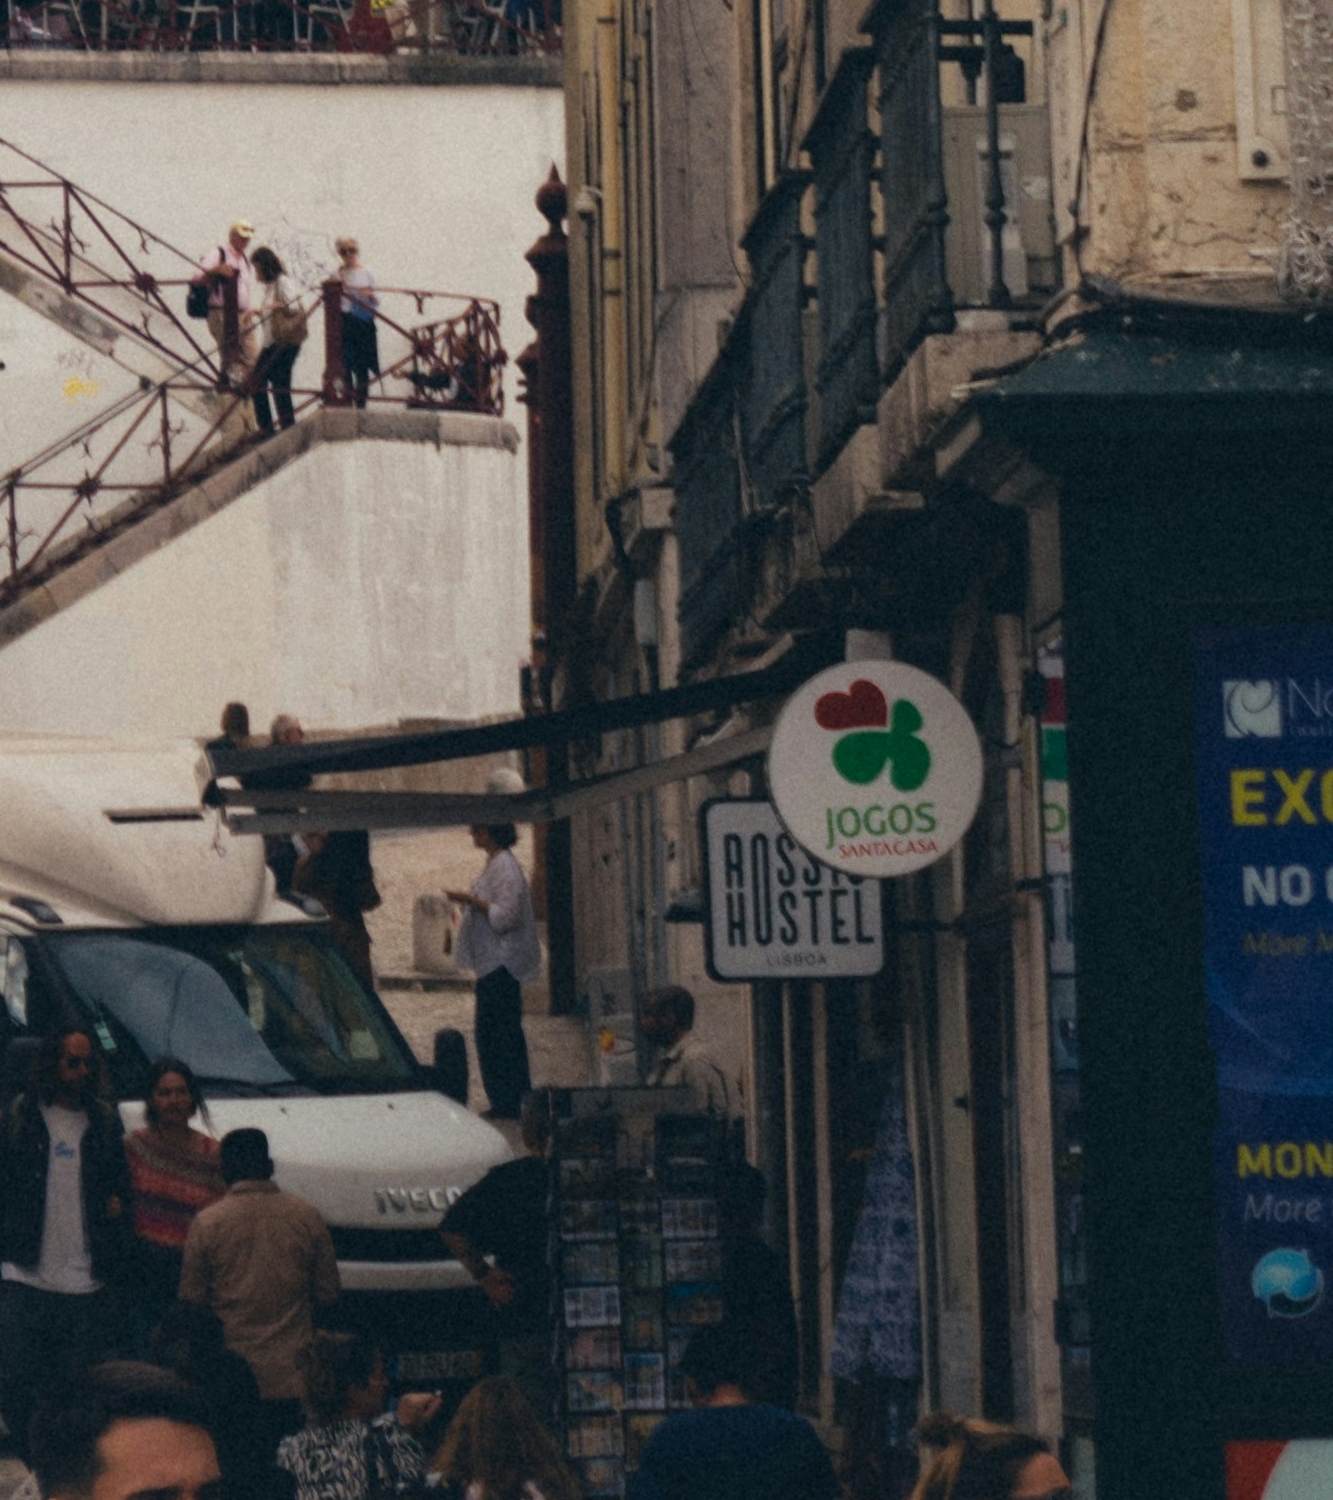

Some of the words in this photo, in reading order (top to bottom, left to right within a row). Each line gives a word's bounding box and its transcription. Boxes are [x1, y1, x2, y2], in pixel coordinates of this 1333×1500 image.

[825, 803, 938, 849] JOGOS
[1242, 864, 1313, 908] NO
[727, 889, 875, 947] HOSTEL
[766, 952, 828, 967] LISBOA
[1245, 1194, 1323, 1223] More
